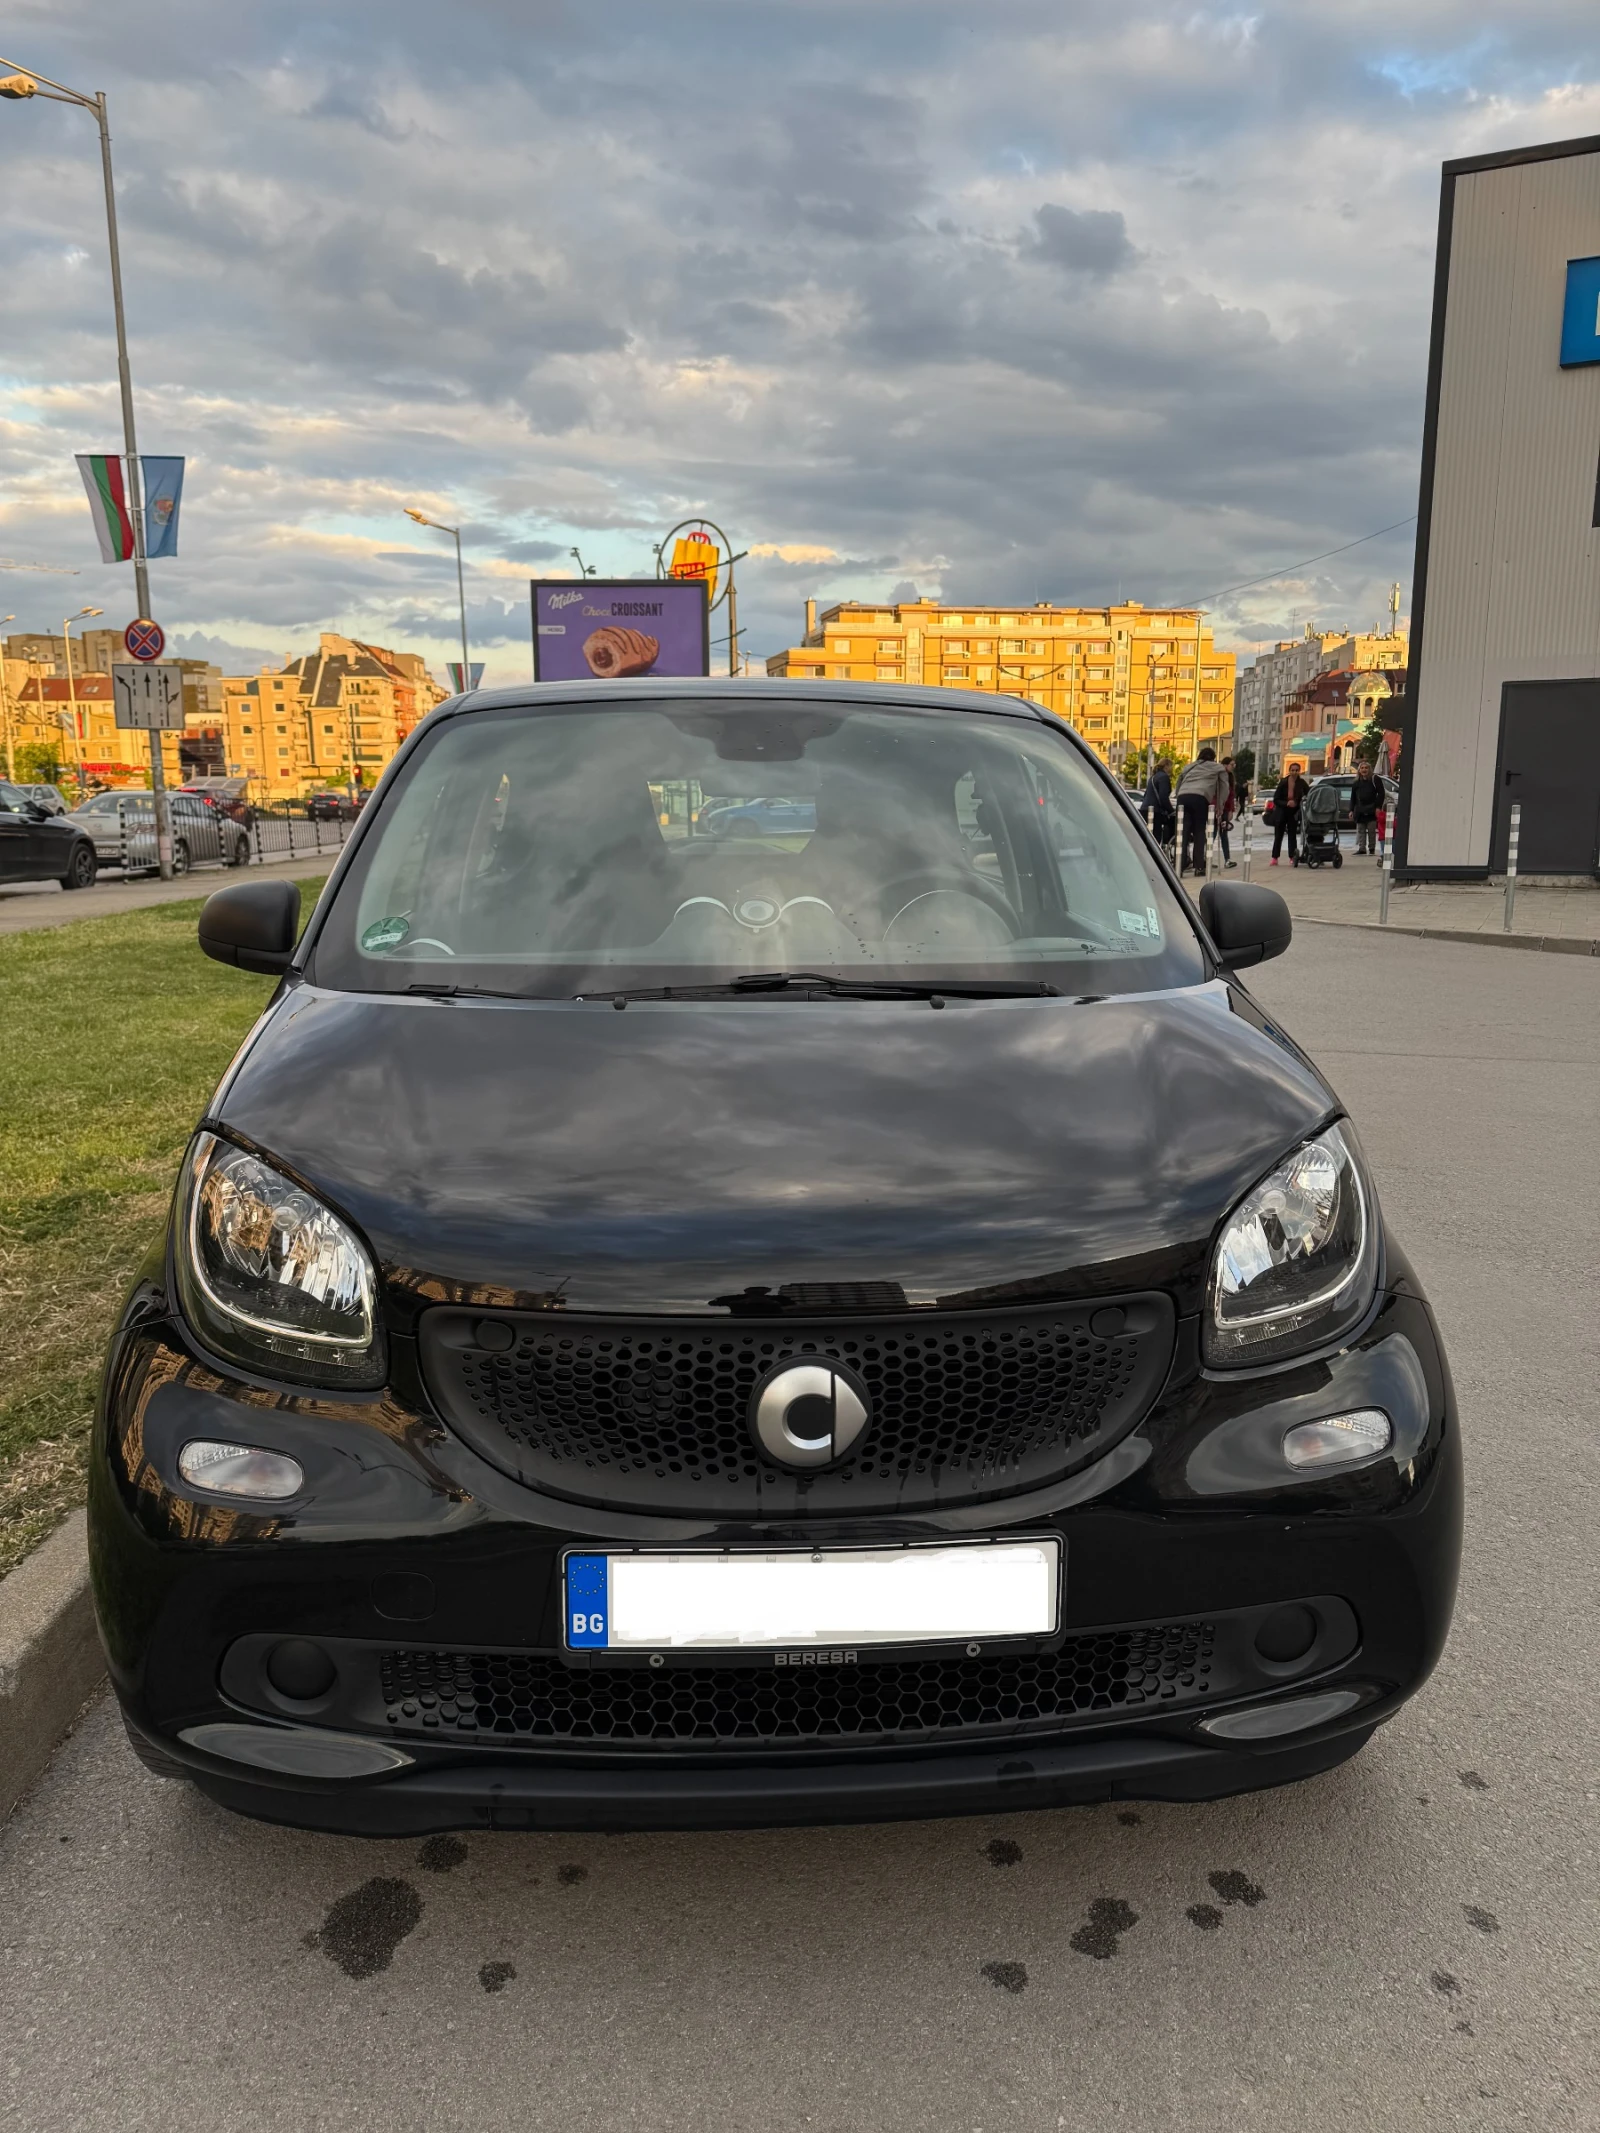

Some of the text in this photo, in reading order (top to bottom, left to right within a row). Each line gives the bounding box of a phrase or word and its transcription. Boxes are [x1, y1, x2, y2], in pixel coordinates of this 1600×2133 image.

[548, 591, 584, 610] Milka
[572, 1613, 604, 1635] BG
[774, 1651, 858, 1667] BERESA
